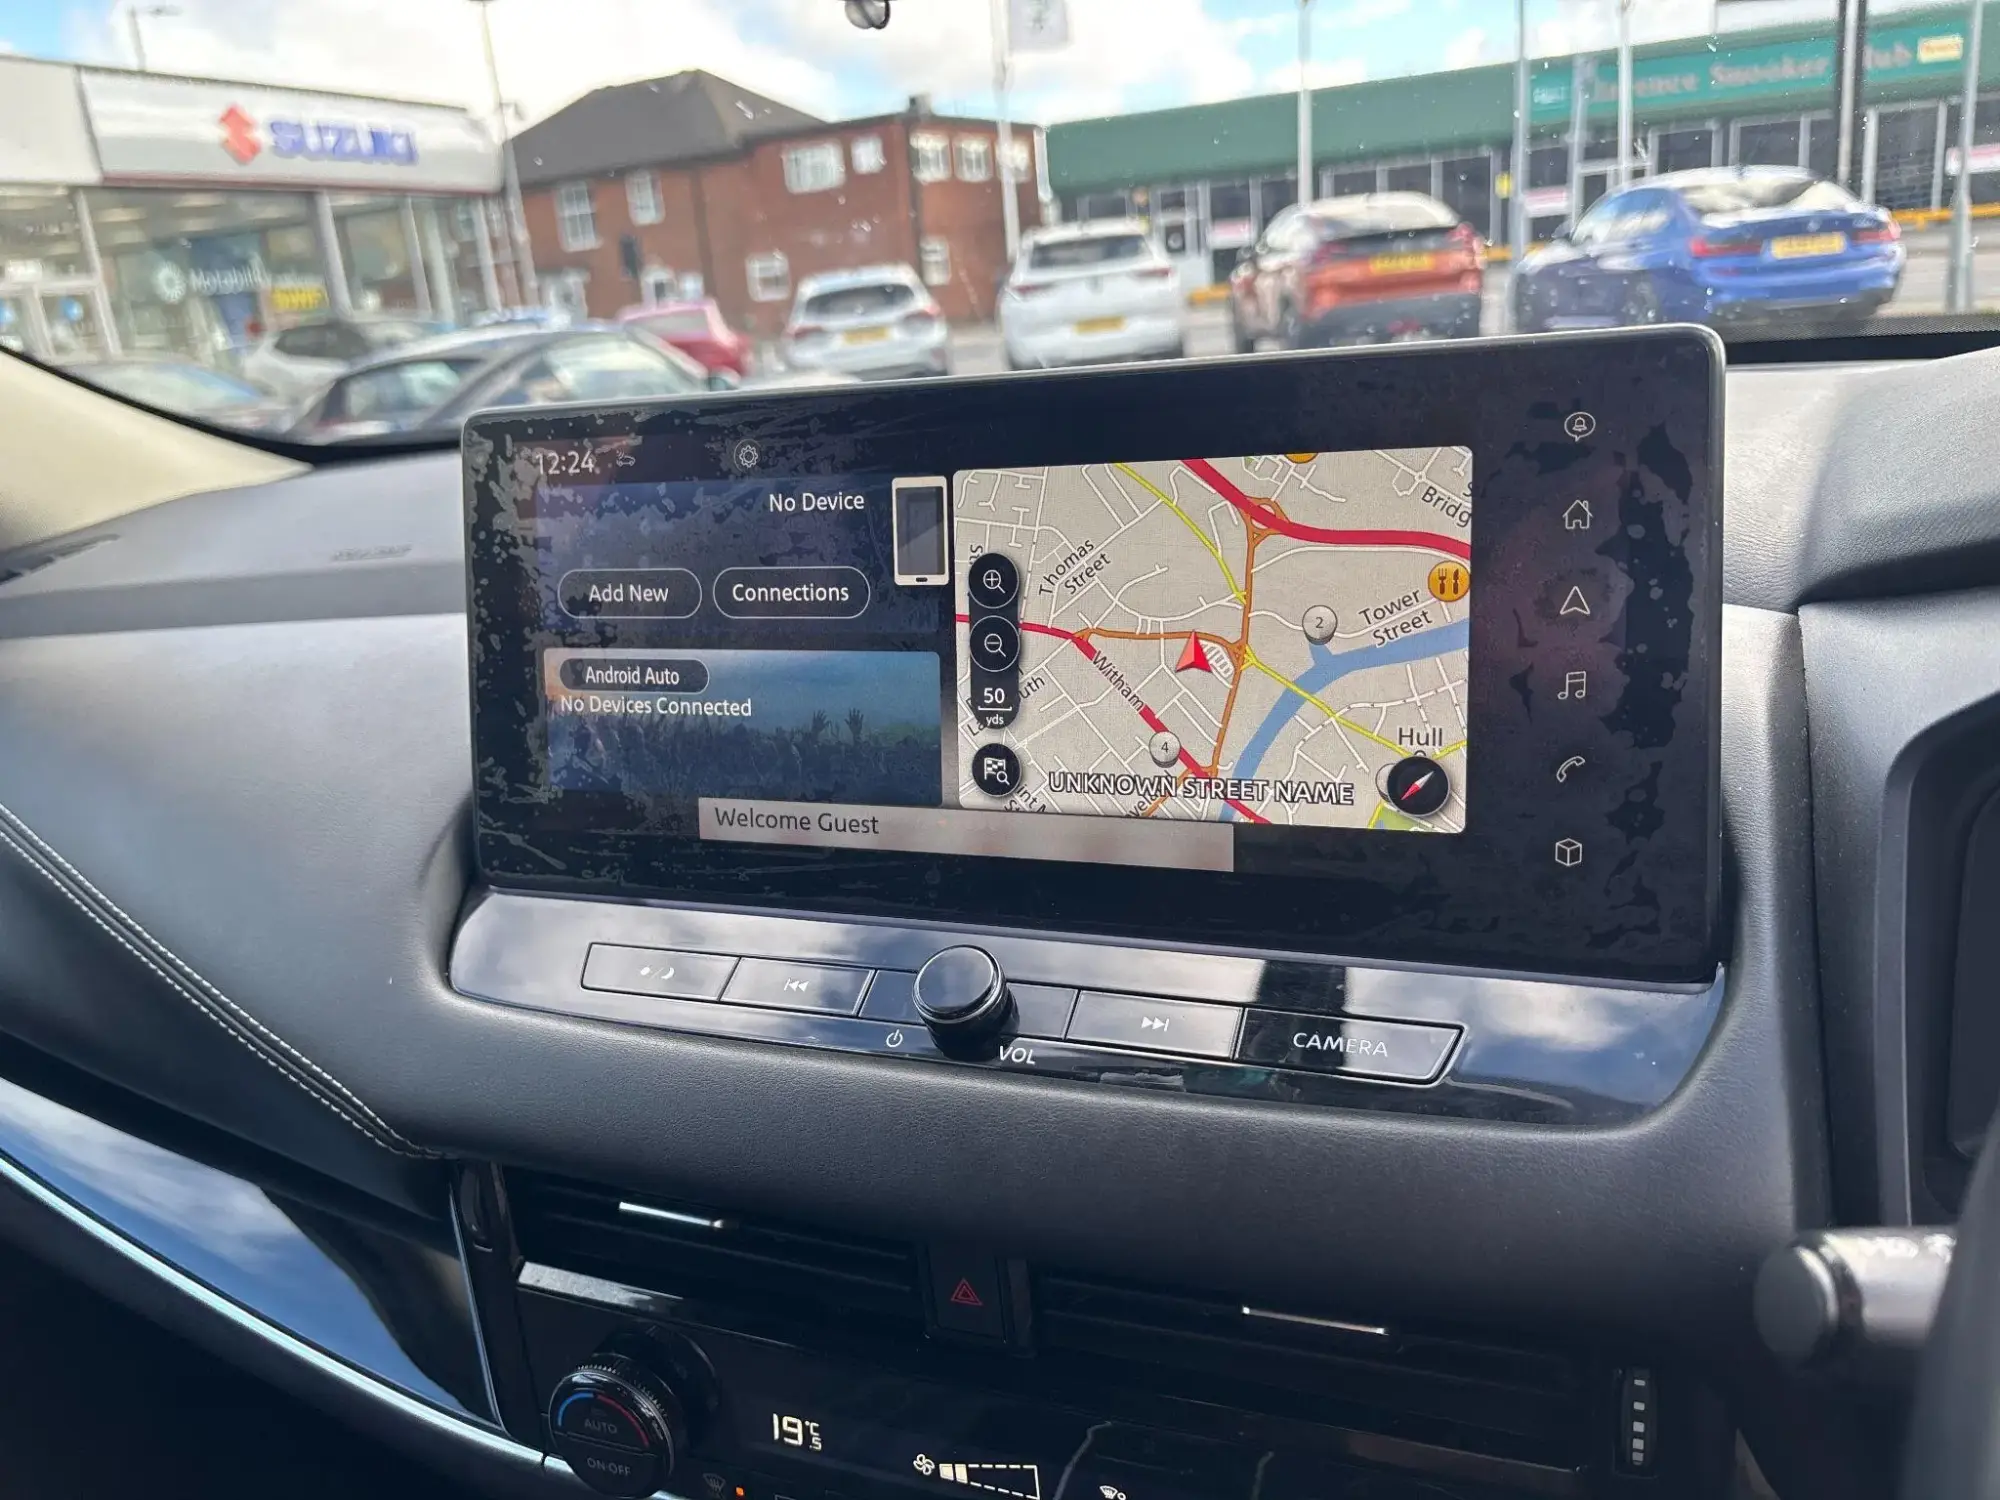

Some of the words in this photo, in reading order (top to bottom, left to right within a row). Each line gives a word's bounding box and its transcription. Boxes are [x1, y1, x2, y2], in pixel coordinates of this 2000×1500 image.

[535, 450, 596, 475] 12:24
[769, 494, 797, 513] No
[802, 492, 865, 511] Device
[1421, 486, 1473, 528] Bridg
[1038, 539, 1095, 597] Thomas
[1064, 553, 1112, 595] Street
[588, 583, 624, 602] Add
[628, 584, 669, 602] New
[732, 582, 850, 602] Connections
[1358, 590, 1420, 625] Tower
[1314, 616, 1324, 629] 2
[1373, 610, 1433, 647] Street
[585, 665, 641, 685] Android
[645, 667, 680, 686] Auto
[1092, 650, 1145, 711] Witham
[560, 695, 585, 713] No
[589, 696, 652, 715] Devices
[656, 697, 752, 717] Connected
[984, 687, 1005, 704] 50
[985, 713, 1005, 727] yds
[1161, 742, 1169, 753] 4
[1398, 727, 1443, 747] Hull
[1049, 771, 1178, 798] UNKNOWN
[1183, 777, 1269, 802] STREET
[1274, 780, 1354, 805] NAME
[715, 807, 811, 831] Welcome
[817, 812, 879, 835] Guest
[999, 1045, 1036, 1065] VOL
[1292, 1032, 1389, 1058] CAMERA
[584, 1417, 618, 1435] AUTO
